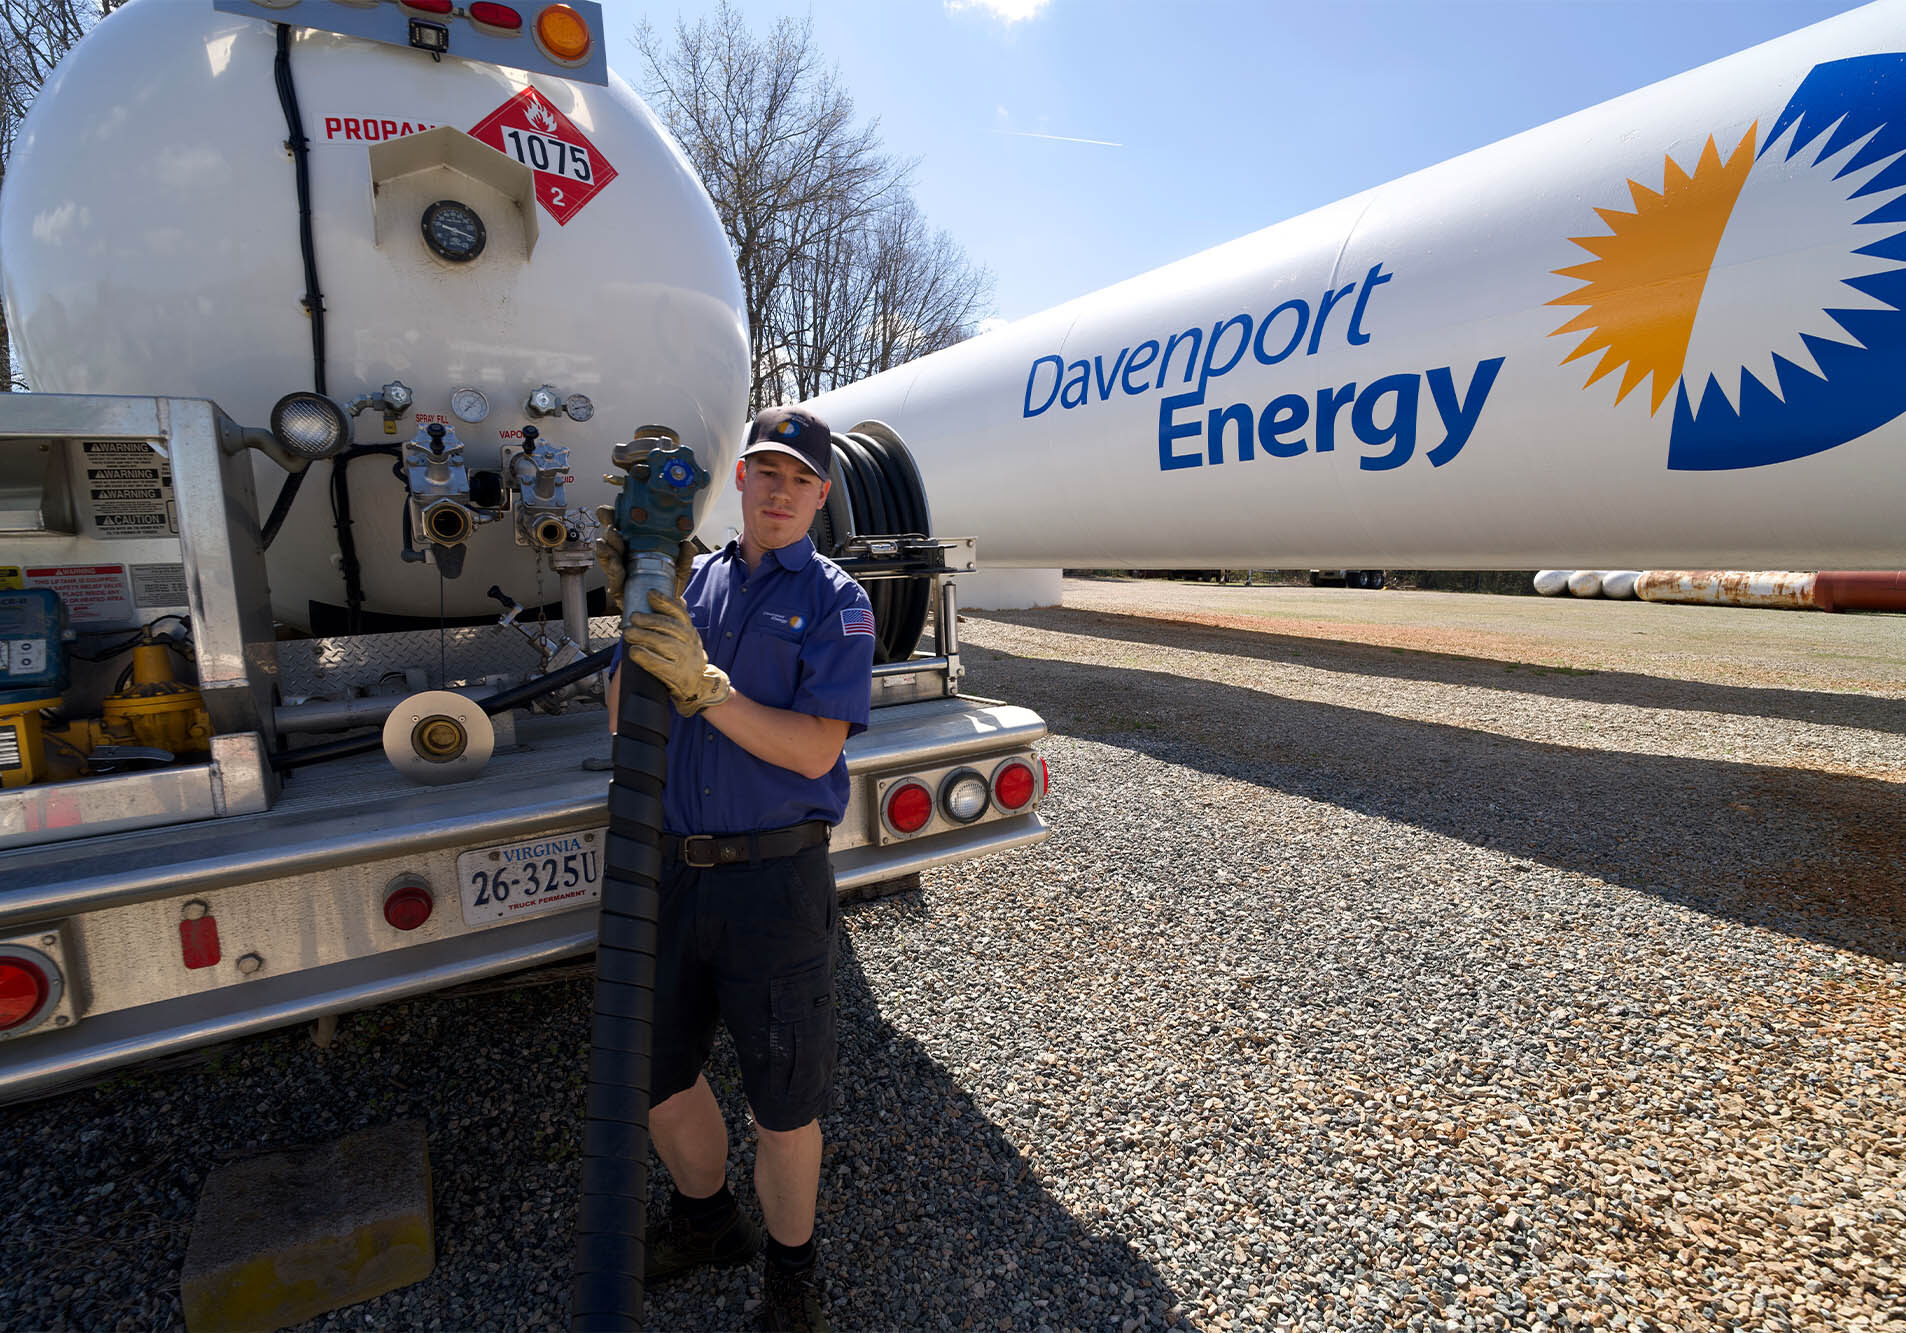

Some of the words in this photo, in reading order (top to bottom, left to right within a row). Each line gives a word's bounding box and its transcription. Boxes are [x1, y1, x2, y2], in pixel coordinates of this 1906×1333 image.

[325, 117, 436, 140] PROPA
[507, 130, 591, 182] 1075
[550, 187, 565, 207] 2
[1022, 262, 1394, 418] Davenport
[415, 413, 434, 423] SPRAY
[437, 414, 449, 424] FILL
[1158, 356, 1505, 471] Energy
[100, 443, 149, 452] WARNING
[103, 469, 153, 479] WARNING
[107, 489, 156, 498] WARNING
[114, 515, 160, 524] CAUTION
[504, 838, 581, 862] VIRGINIA
[471, 851, 597, 907] 26-325U
[508, 900, 536, 910] TRUCK
[538, 889, 587, 905] PERMANENT
